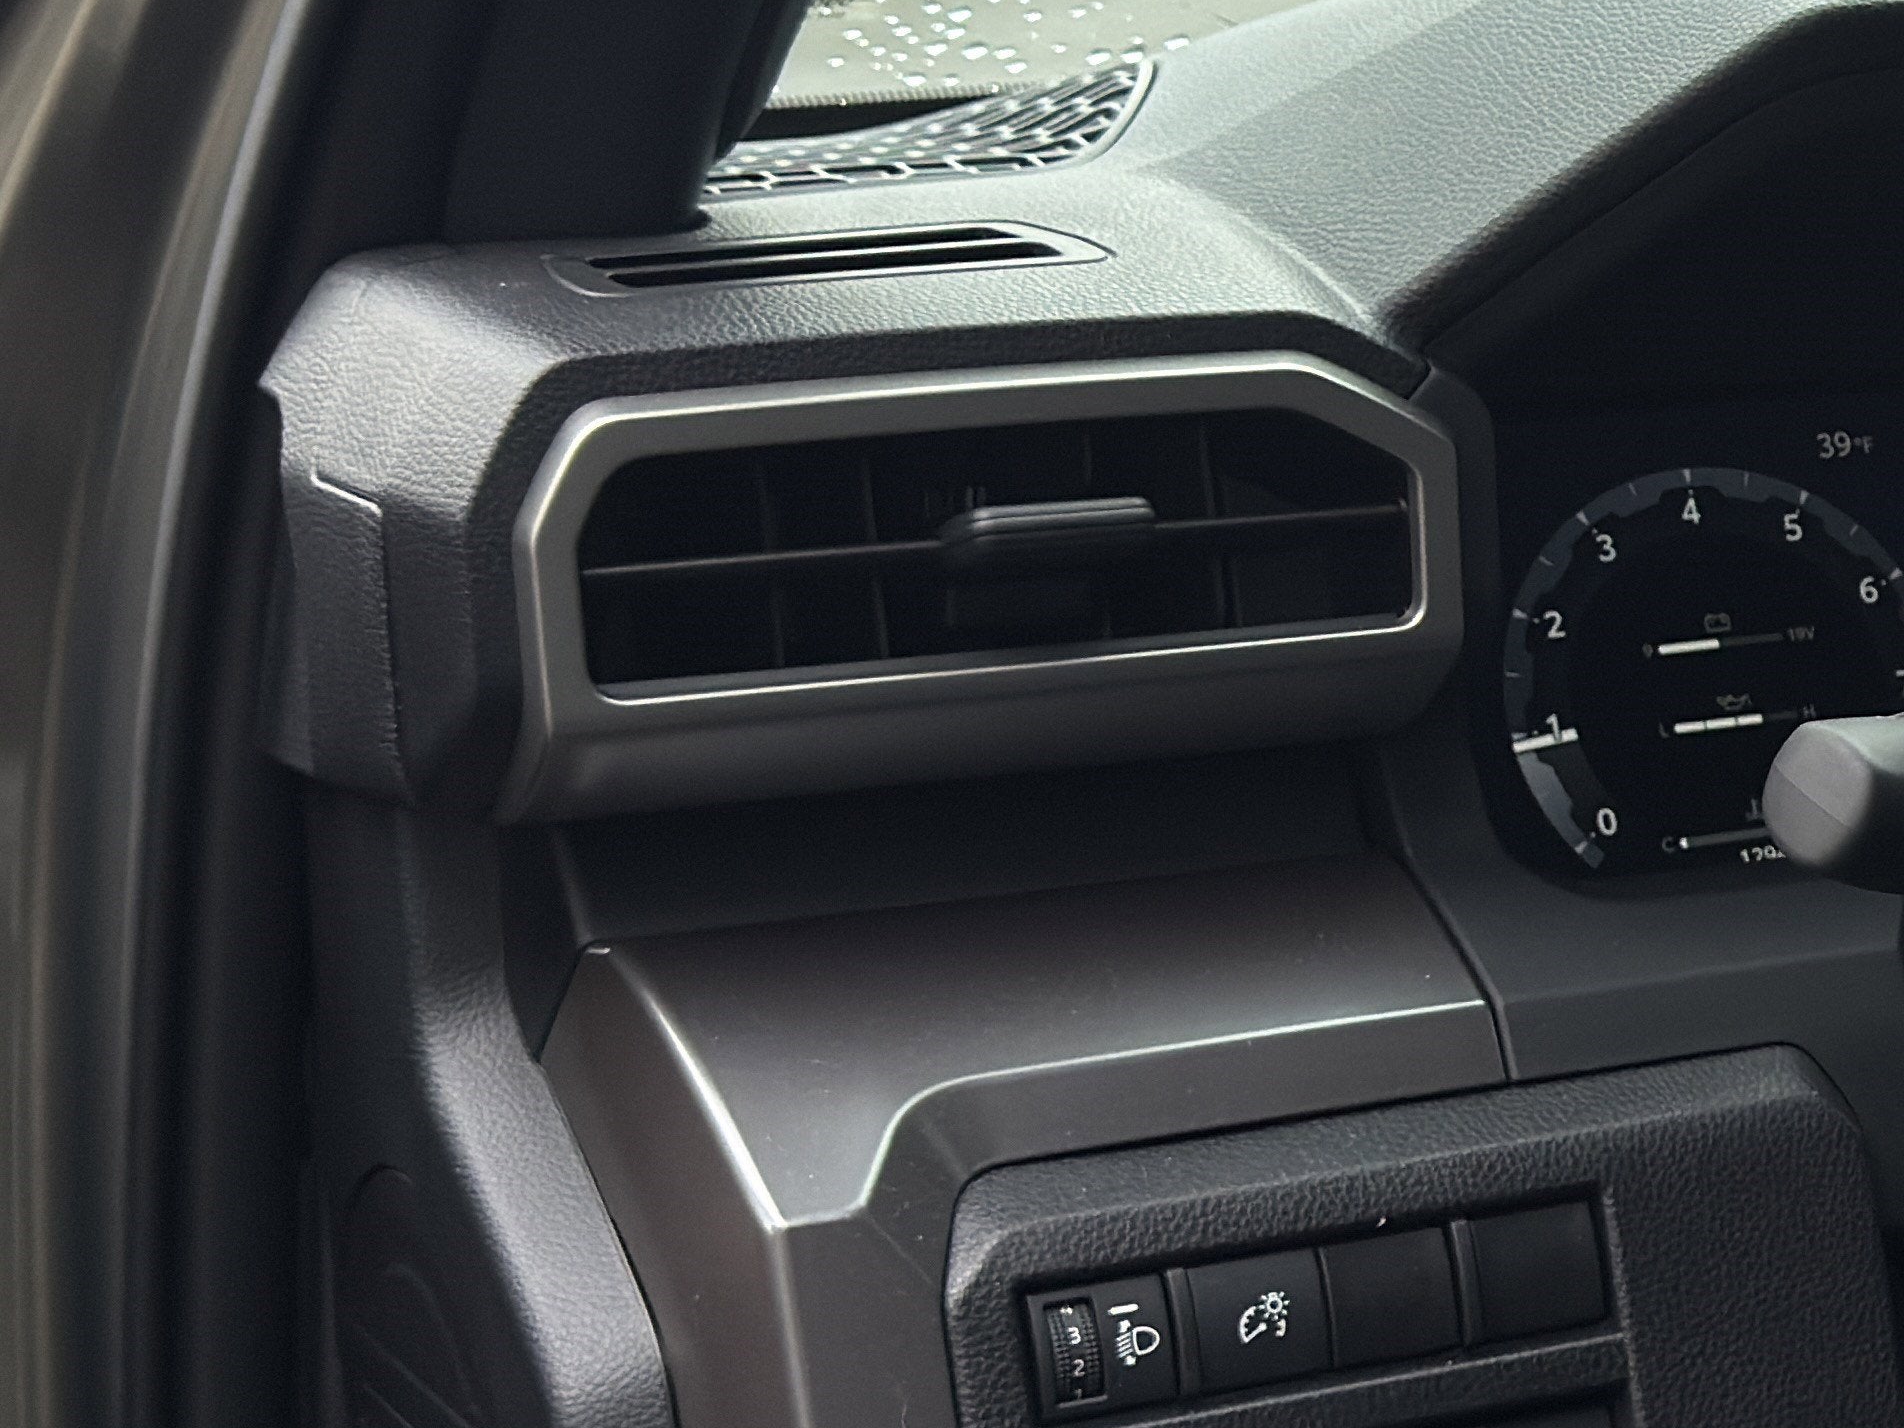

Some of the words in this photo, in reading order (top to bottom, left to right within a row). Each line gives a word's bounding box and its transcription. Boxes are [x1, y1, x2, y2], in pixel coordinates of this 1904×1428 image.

[1681, 497, 1701, 524] 4
[1783, 512, 1803, 542] 5
[1596, 534, 1617, 562] 3
[1859, 576, 1879, 604] 6
[1543, 610, 1566, 639] 2
[1597, 807, 1618, 836] 0
[1067, 1326, 1081, 1345] 3
[1073, 1358, 1086, 1377] 2
